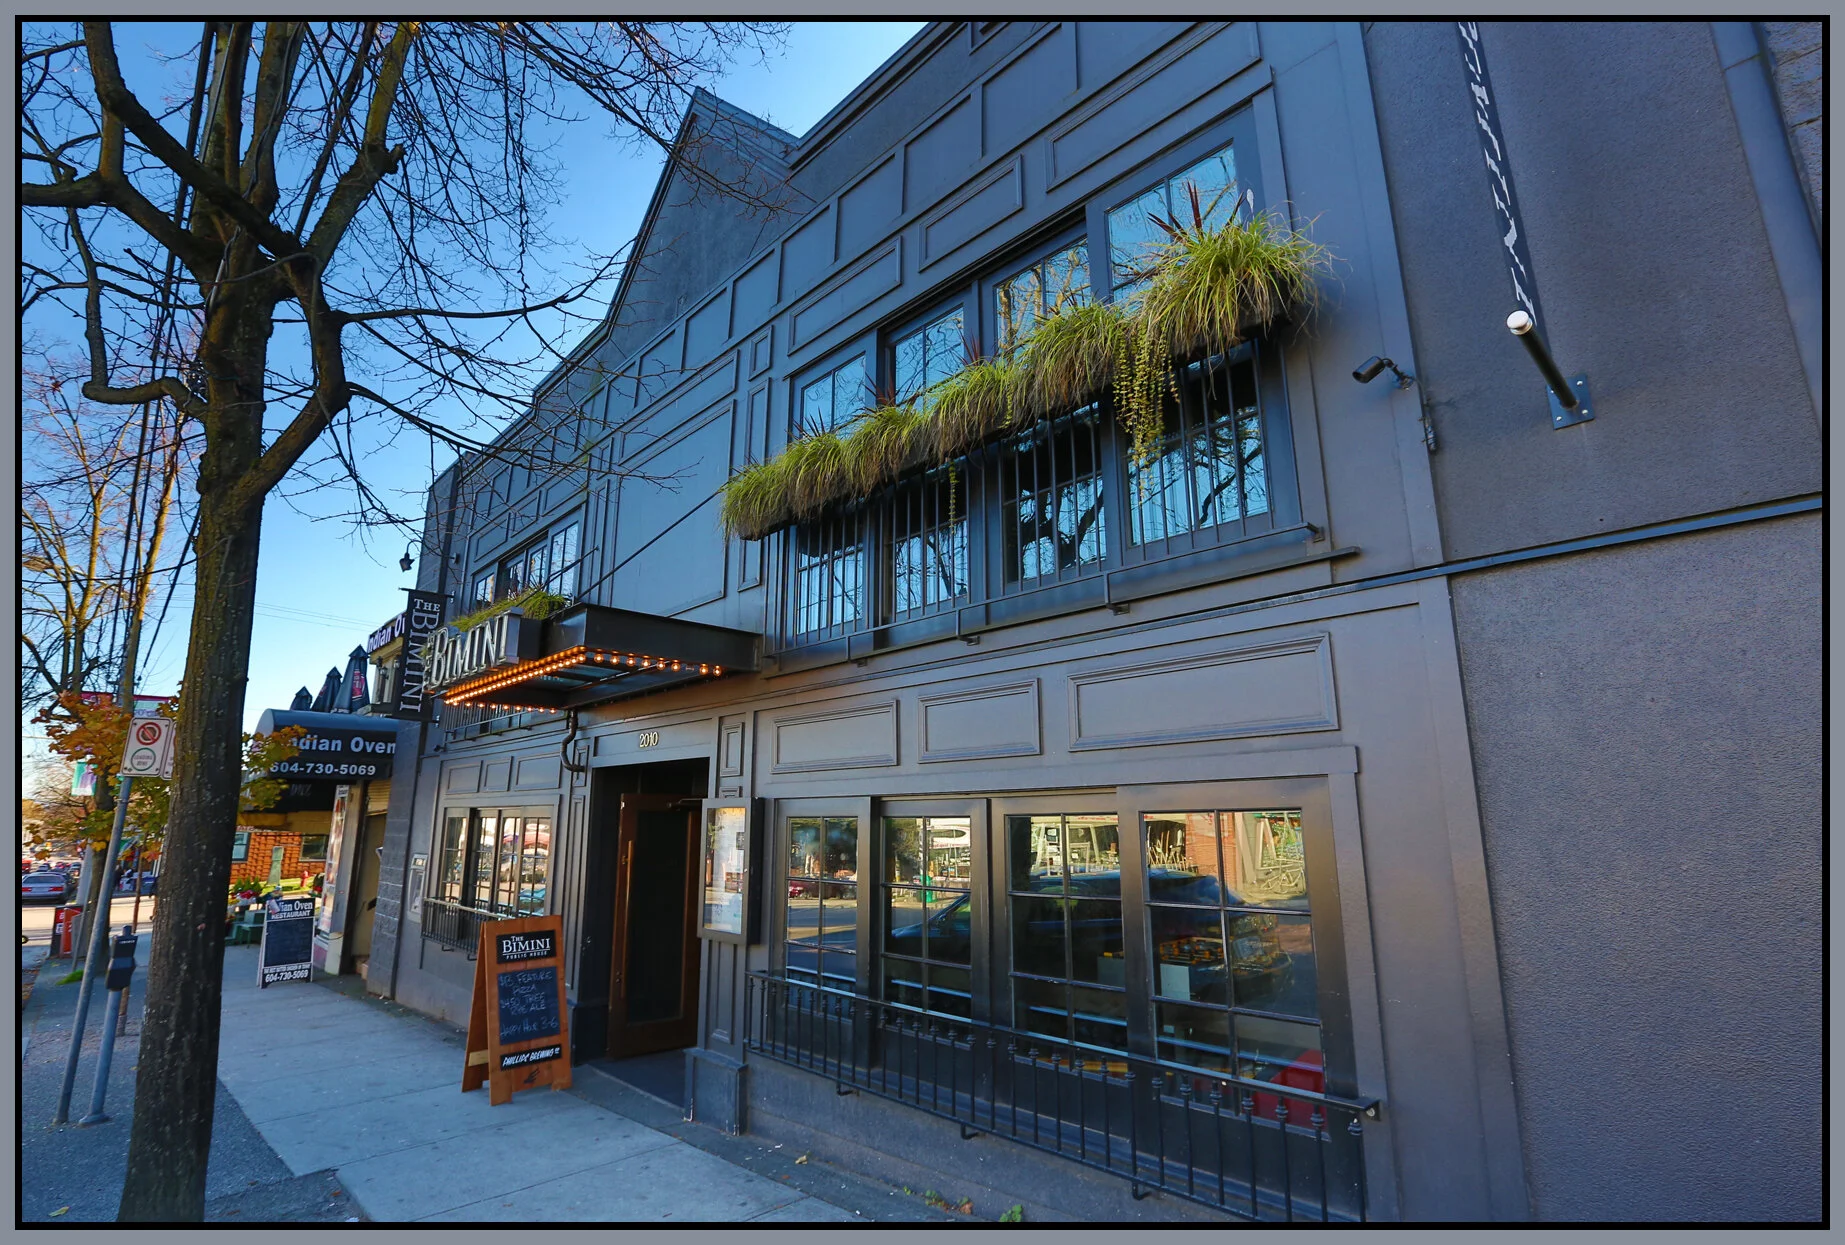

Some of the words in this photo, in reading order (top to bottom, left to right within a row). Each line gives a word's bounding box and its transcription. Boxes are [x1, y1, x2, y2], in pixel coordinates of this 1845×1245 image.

[414, 599, 440, 612] THE
[430, 609, 510, 690] BIMINI
[350, 736, 396, 754] Oven
[639, 731, 659, 748] 2010
[270, 762, 376, 776] 604-730-5069
[293, 900, 313, 911] Oven
[502, 938, 551, 953] BIMINI
[265, 969, 309, 983] 604-730-5069
